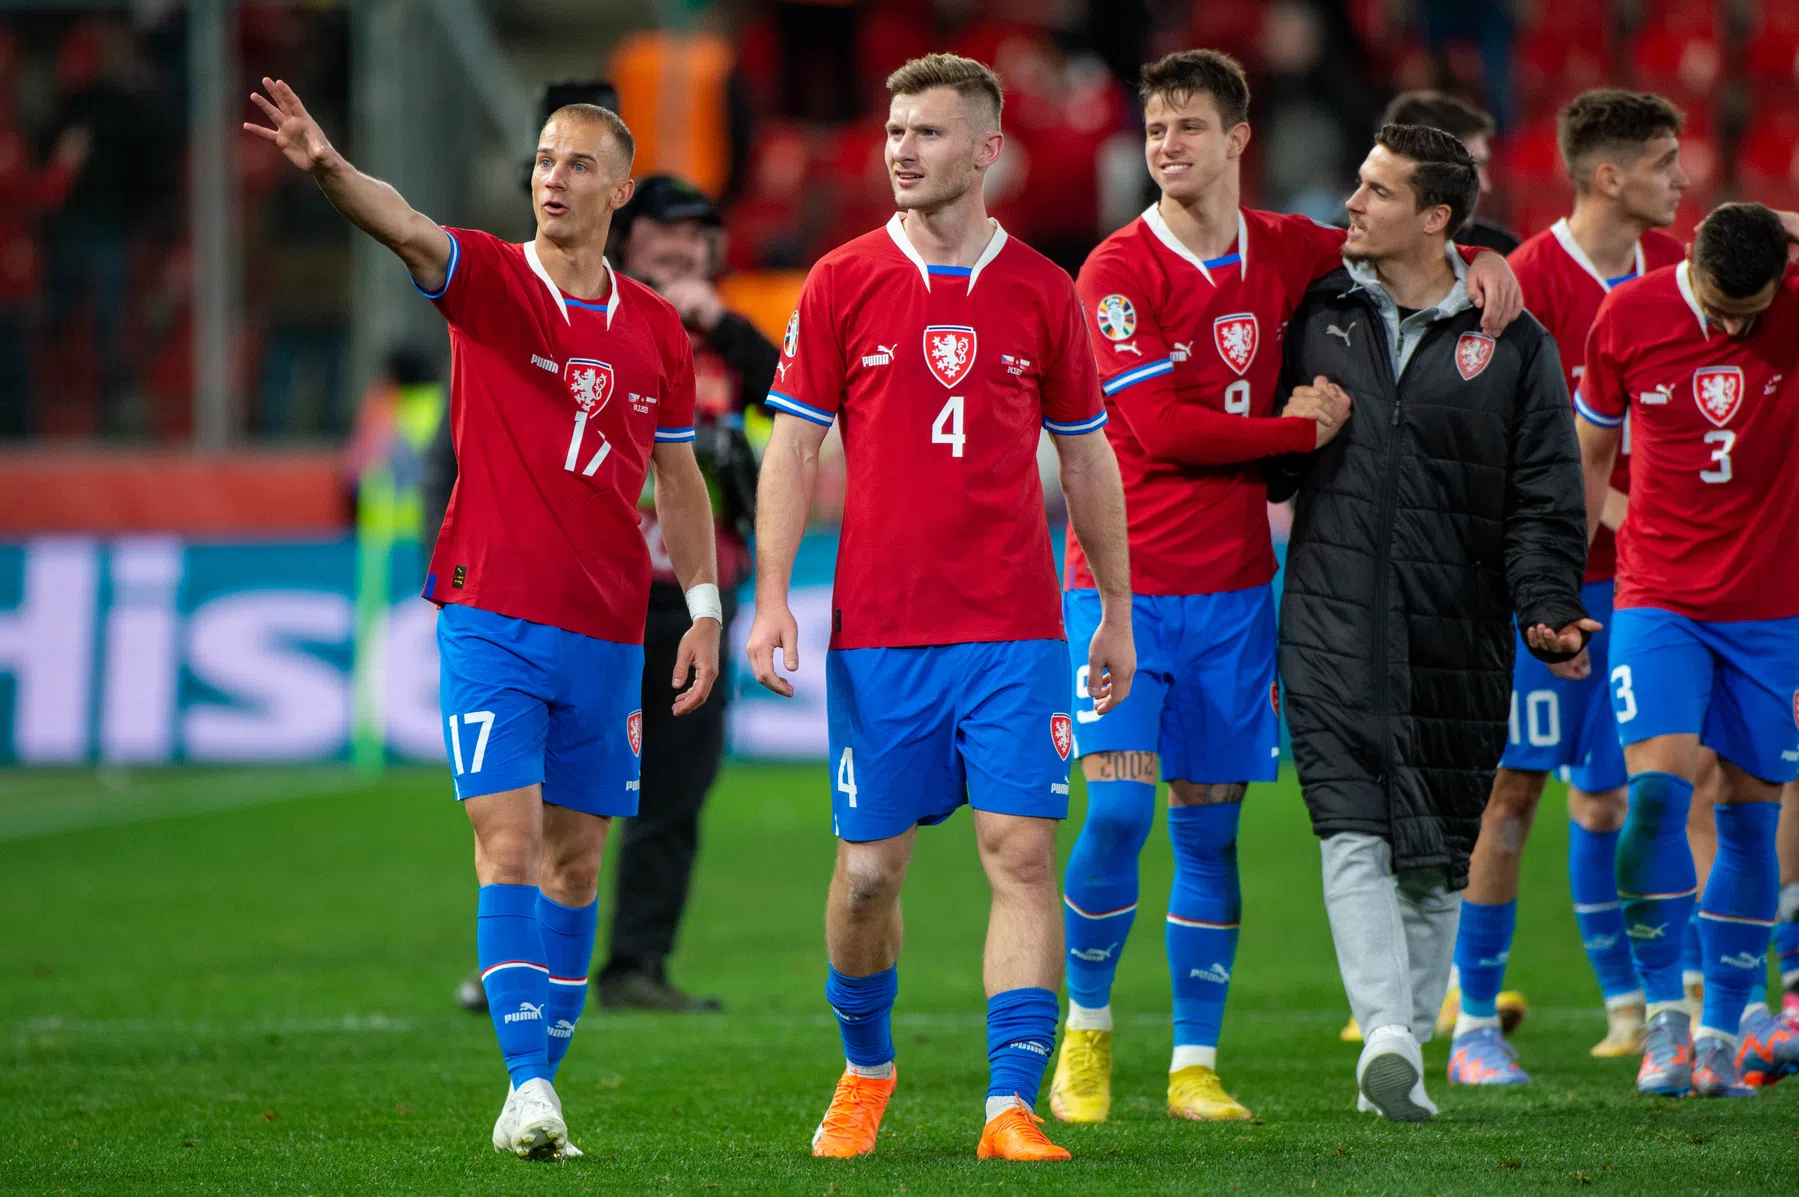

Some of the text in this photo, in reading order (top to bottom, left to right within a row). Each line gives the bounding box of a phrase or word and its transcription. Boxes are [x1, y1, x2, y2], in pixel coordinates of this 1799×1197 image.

[530, 353, 559, 374] PUMA
[861, 353, 889, 367] PUMA
[931, 396, 966, 457] 4
[1224, 379, 1251, 418] 9
[564, 411, 612, 477] 17
[1700, 429, 1737, 484] 3
[1508, 689, 1562, 747] 10
[1611, 664, 1638, 724] 3
[449, 710, 496, 775] 17
[837, 746, 857, 808] 4
[505, 1012, 538, 1024] PUMA
[547, 1026, 571, 1038] UMA
